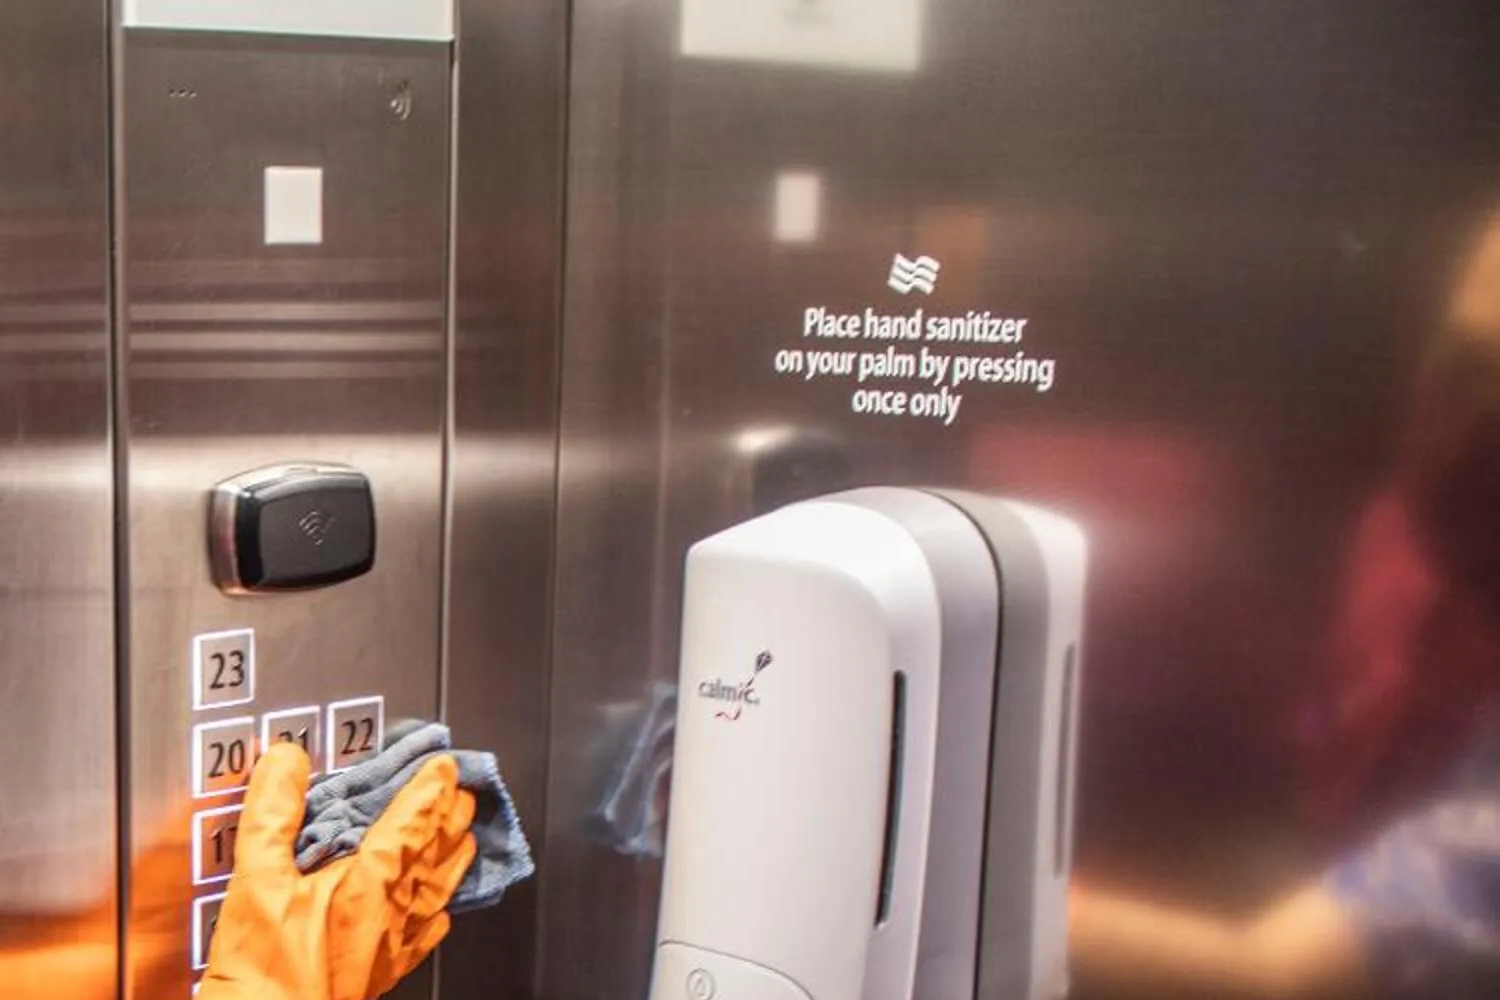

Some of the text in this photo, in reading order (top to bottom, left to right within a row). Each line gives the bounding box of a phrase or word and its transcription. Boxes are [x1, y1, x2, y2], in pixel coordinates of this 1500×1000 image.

[803, 306, 1028, 343] Place hand sanitizer
[774, 345, 1056, 392] on your palm by pressing
[852, 386, 962, 426] once only
[208, 650, 246, 690] 23
[340, 716, 374, 756] 22
[208, 738, 246, 778] 20
